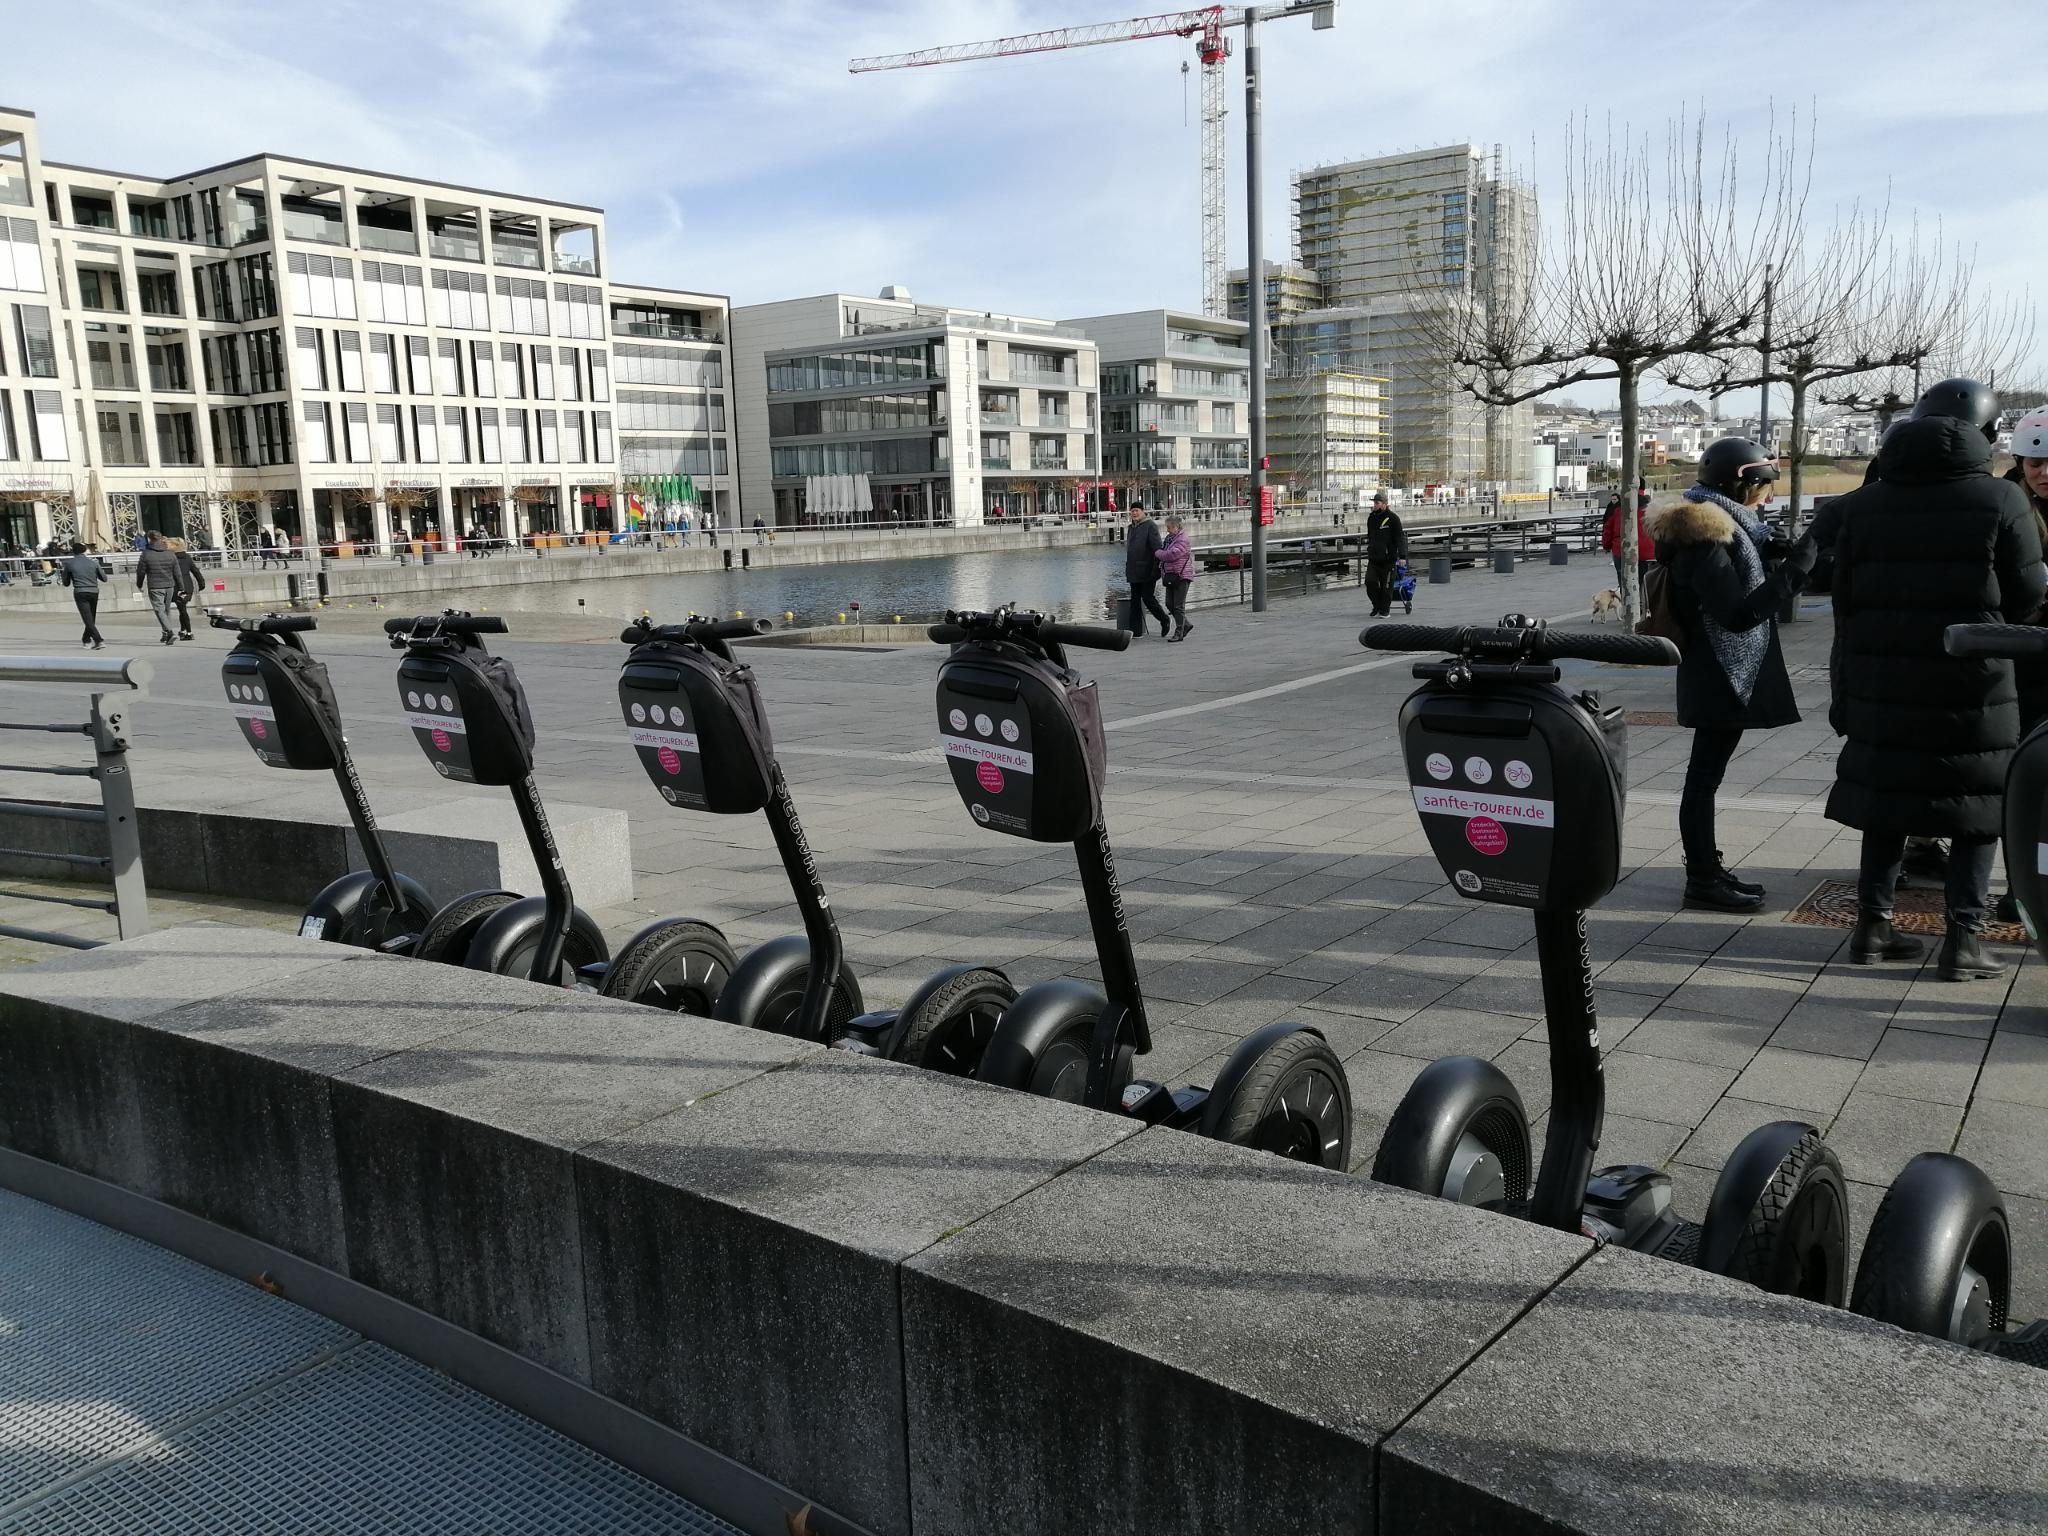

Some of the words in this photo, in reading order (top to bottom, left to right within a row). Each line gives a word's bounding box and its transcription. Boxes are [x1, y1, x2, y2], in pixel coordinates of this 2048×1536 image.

[144, 480, 169, 489] RIVA
[947, 741, 1028, 768] sanfte-TOUREN.de
[1423, 792, 1546, 820] sanfte-TOUREN.de
[775, 783, 823, 887] SEGWAY
